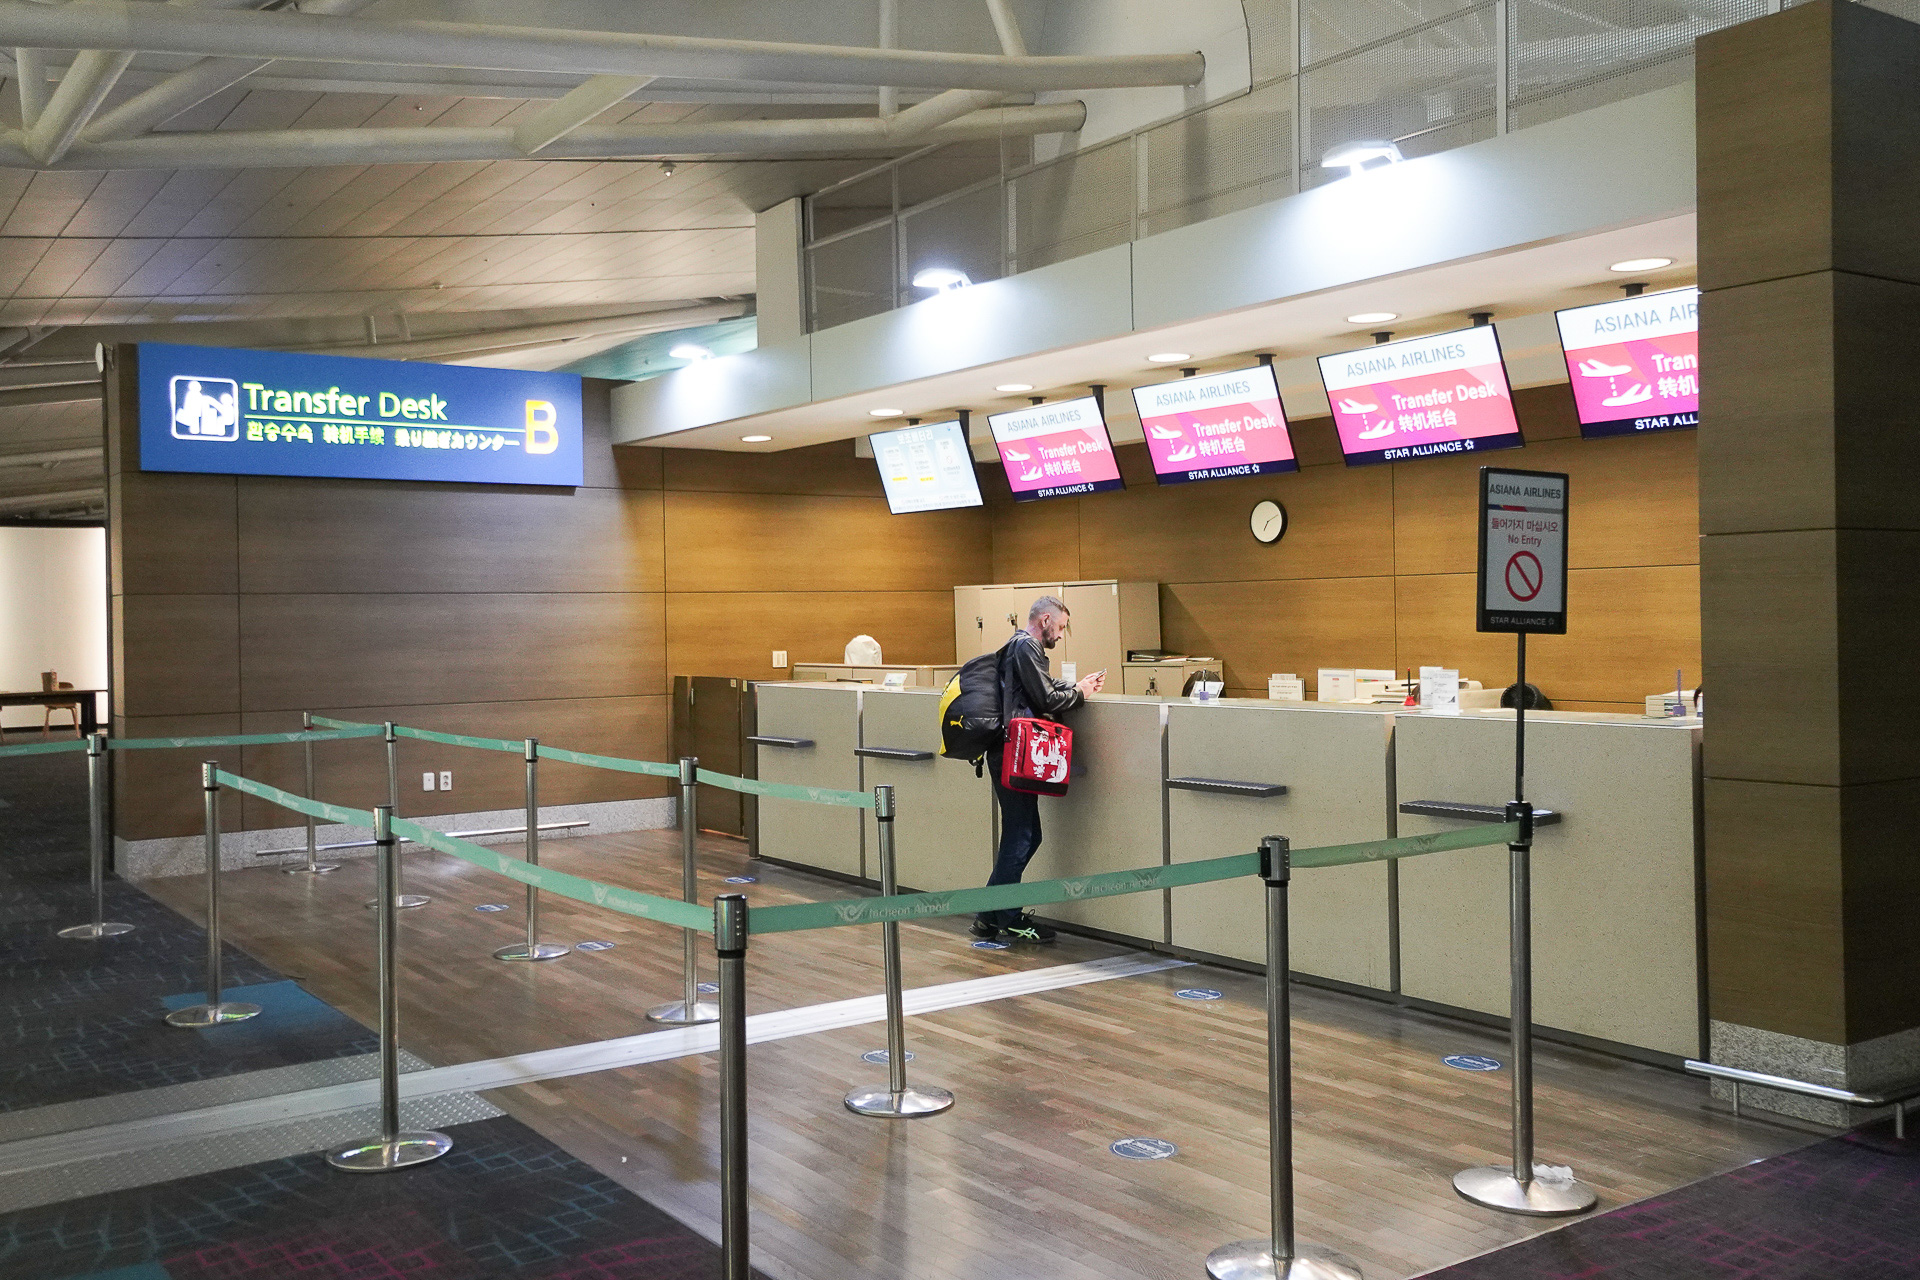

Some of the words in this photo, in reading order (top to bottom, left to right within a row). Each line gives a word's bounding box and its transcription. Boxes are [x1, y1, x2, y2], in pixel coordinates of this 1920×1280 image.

[1594, 309, 1661, 334] ASIANA
[1347, 356, 1397, 377] ASIANA
[1401, 343, 1466, 368] AIRLINES
[1651, 353, 1698, 373] Tran
[242, 382, 371, 417] Transfer
[379, 391, 448, 421] Desk
[1156, 389, 1196, 407] ASIANA
[1199, 380, 1250, 400] AIRLINES
[1392, 388, 1453, 411] Transfer
[1455, 381, 1497, 402] Desk
[525, 399, 559, 454] B
[1007, 418, 1039, 433] ASIANA
[1041, 409, 1082, 427] AIRLINES
[1192, 418, 1242, 438] Transfer
[1243, 413, 1277, 431] Desk
[1397, 407, 1458, 433] 转机柜台
[1635, 417, 1669, 430] STAR
[247, 420, 314, 444] 환승수속
[1038, 443, 1077, 460] Transfer
[1077, 438, 1104, 453] Desk
[1198, 436, 1246, 457] 转机柜台
[1384, 448, 1411, 460] STAR
[1412, 441, 1463, 457] ALLIANCE
[1044, 458, 1082, 477] 转机柜台
[1188, 469, 1210, 480] STAR
[1210, 464, 1251, 478] ALLIANCE
[1037, 488, 1055, 498] STAR
[1055, 484, 1087, 496] ALLIANCE
[1489, 483, 1521, 496] ASIANA
[1523, 486, 1561, 499] AIRLINES
[1492, 517, 1523, 530] 들어가지
[1526, 519, 1558, 532] 마십시오
[1507, 534, 1519, 544] No
[1521, 534, 1542, 547] Entry
[1490, 616, 1509, 625] STAR
[1510, 617, 1547, 626] ALLIANCE
